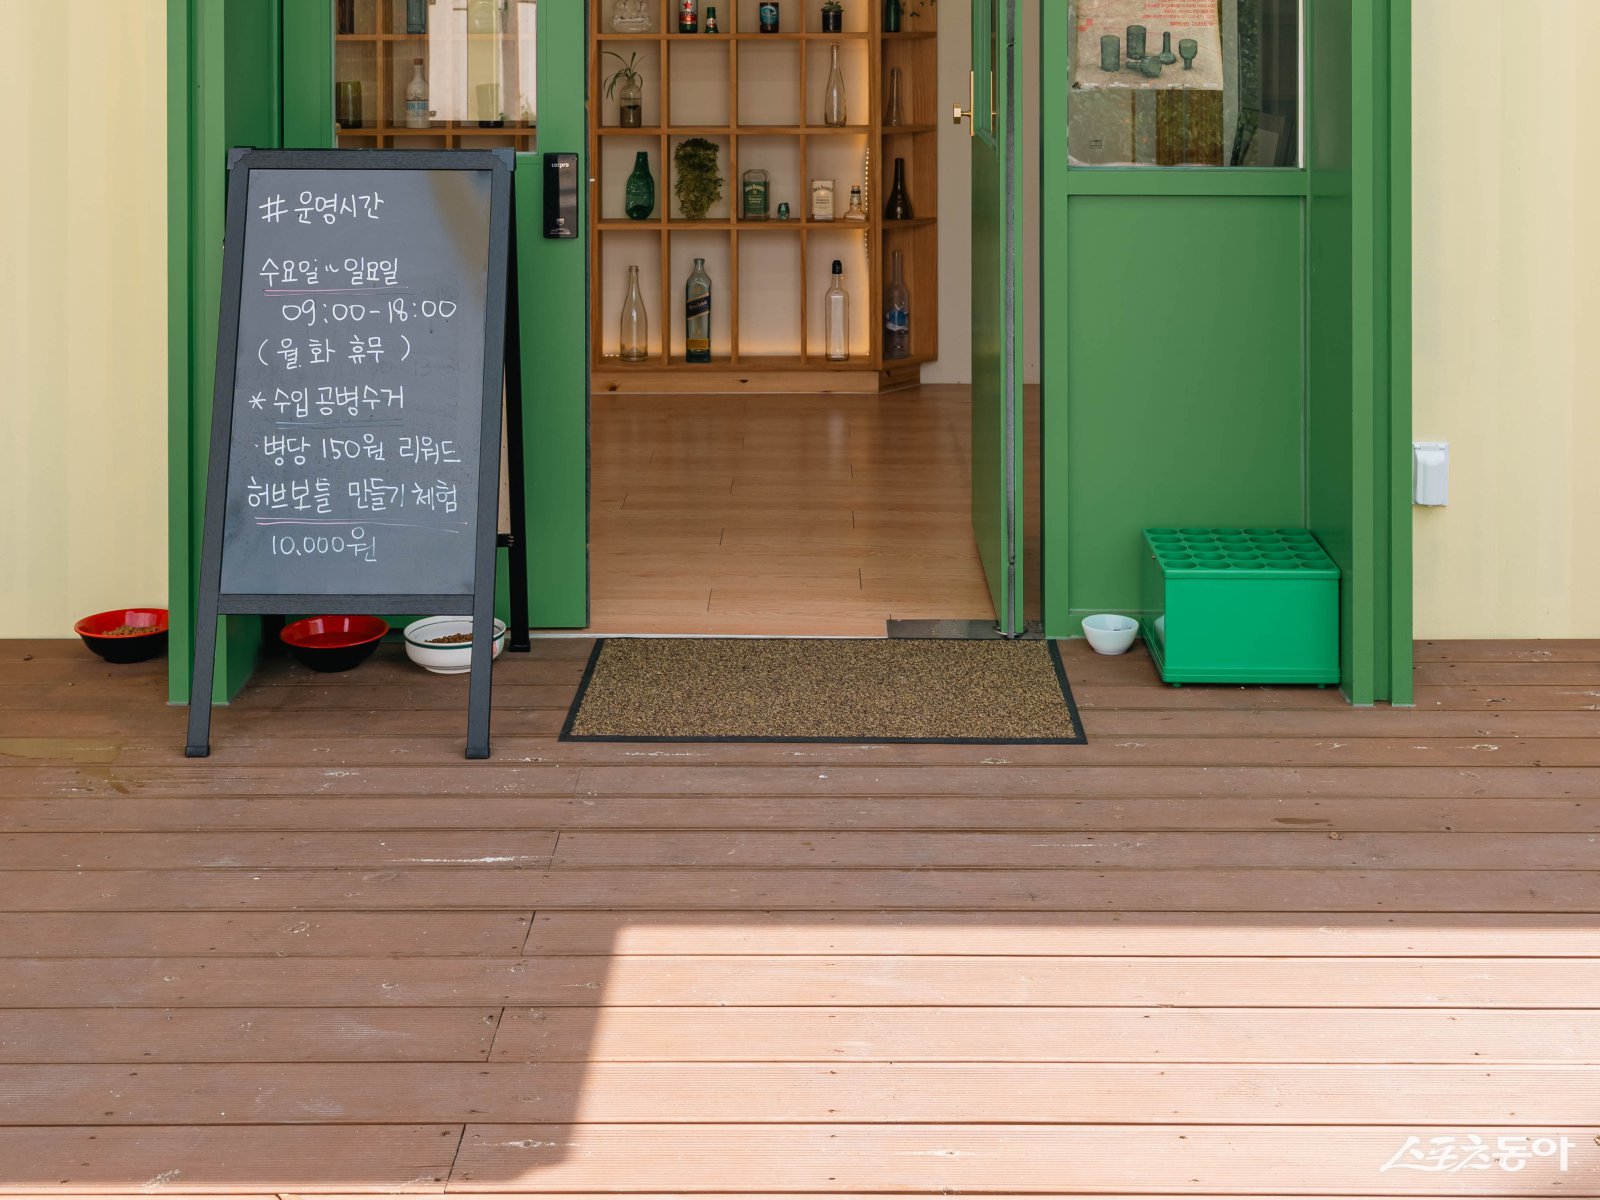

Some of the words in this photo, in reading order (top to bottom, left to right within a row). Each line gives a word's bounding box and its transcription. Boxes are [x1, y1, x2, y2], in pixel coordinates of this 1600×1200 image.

[322, 433, 385, 461] 150원
[399, 435, 461, 464] 리워드
[247, 476, 332, 513] 허브보틀
